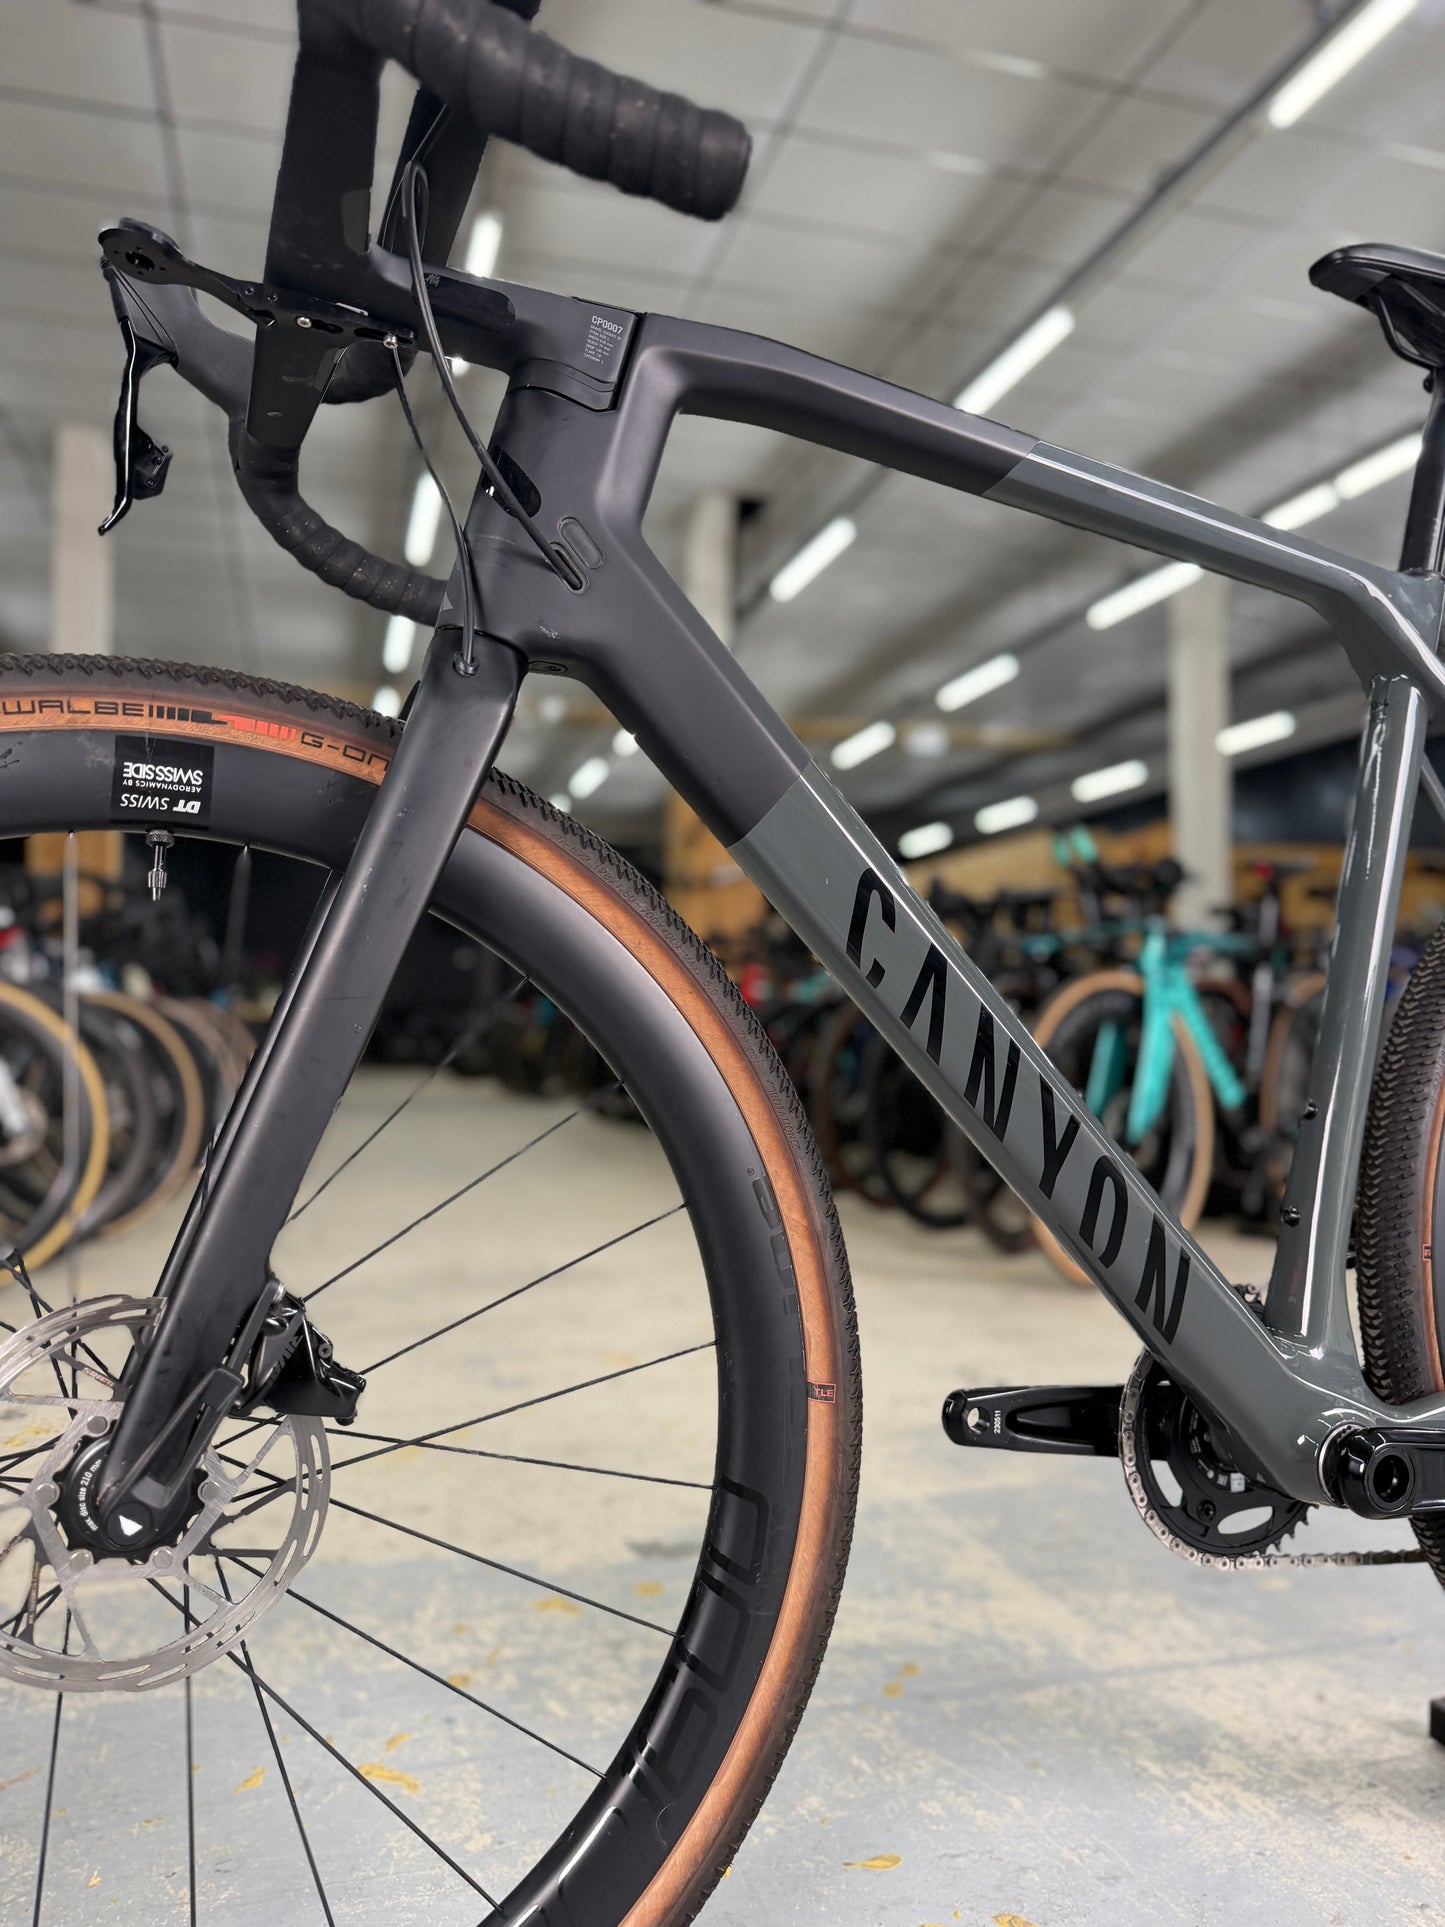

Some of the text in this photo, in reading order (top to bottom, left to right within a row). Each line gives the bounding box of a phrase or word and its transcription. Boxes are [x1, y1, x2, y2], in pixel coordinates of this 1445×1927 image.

[591, 315, 623, 334] CP0007
[122, 778, 202, 793] AERODYNAMICS BY
[120, 793, 201, 814] DT SWISS
[846, 867, 1191, 1345] CANYON
[814, 1387, 835, 1398] TLE
[89, 1458, 103, 1473] mm
[79, 1471, 93, 1486] 210
[76, 1486, 87, 1501] size
[79, 1501, 89, 1517] disc
